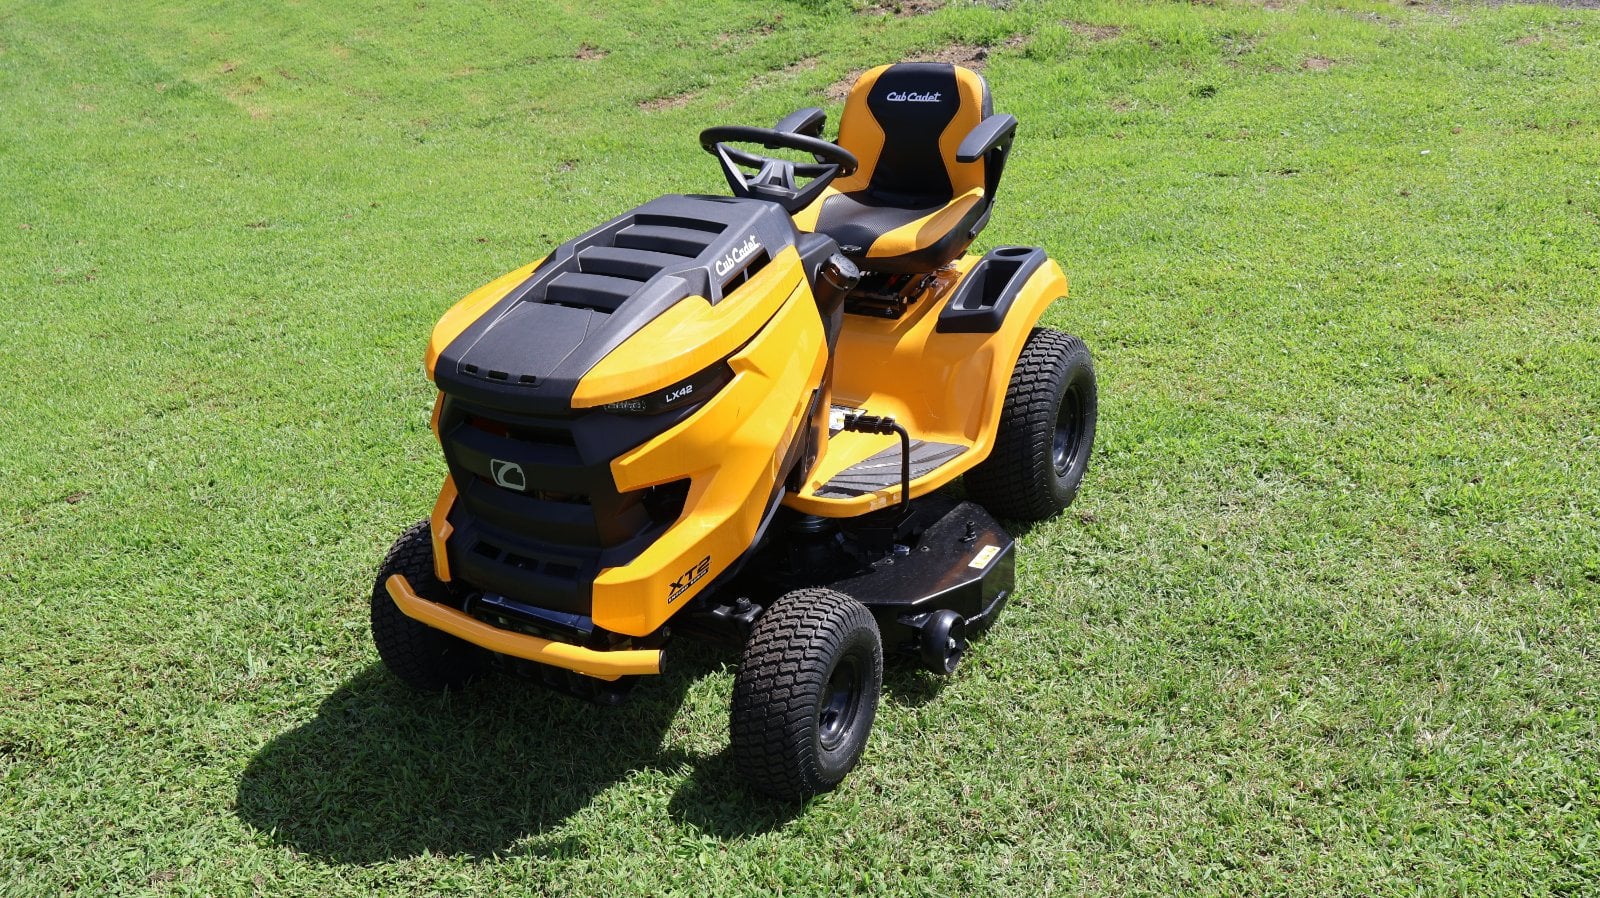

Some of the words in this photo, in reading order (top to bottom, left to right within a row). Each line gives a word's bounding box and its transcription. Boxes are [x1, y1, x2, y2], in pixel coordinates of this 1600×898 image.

[886, 91, 907, 102] Cub
[907, 91, 942, 103] Cadet
[715, 254, 735, 277] Cub
[732, 234, 761, 263] Cadet
[665, 384, 693, 403] LX42
[668, 554, 711, 597] XT2
